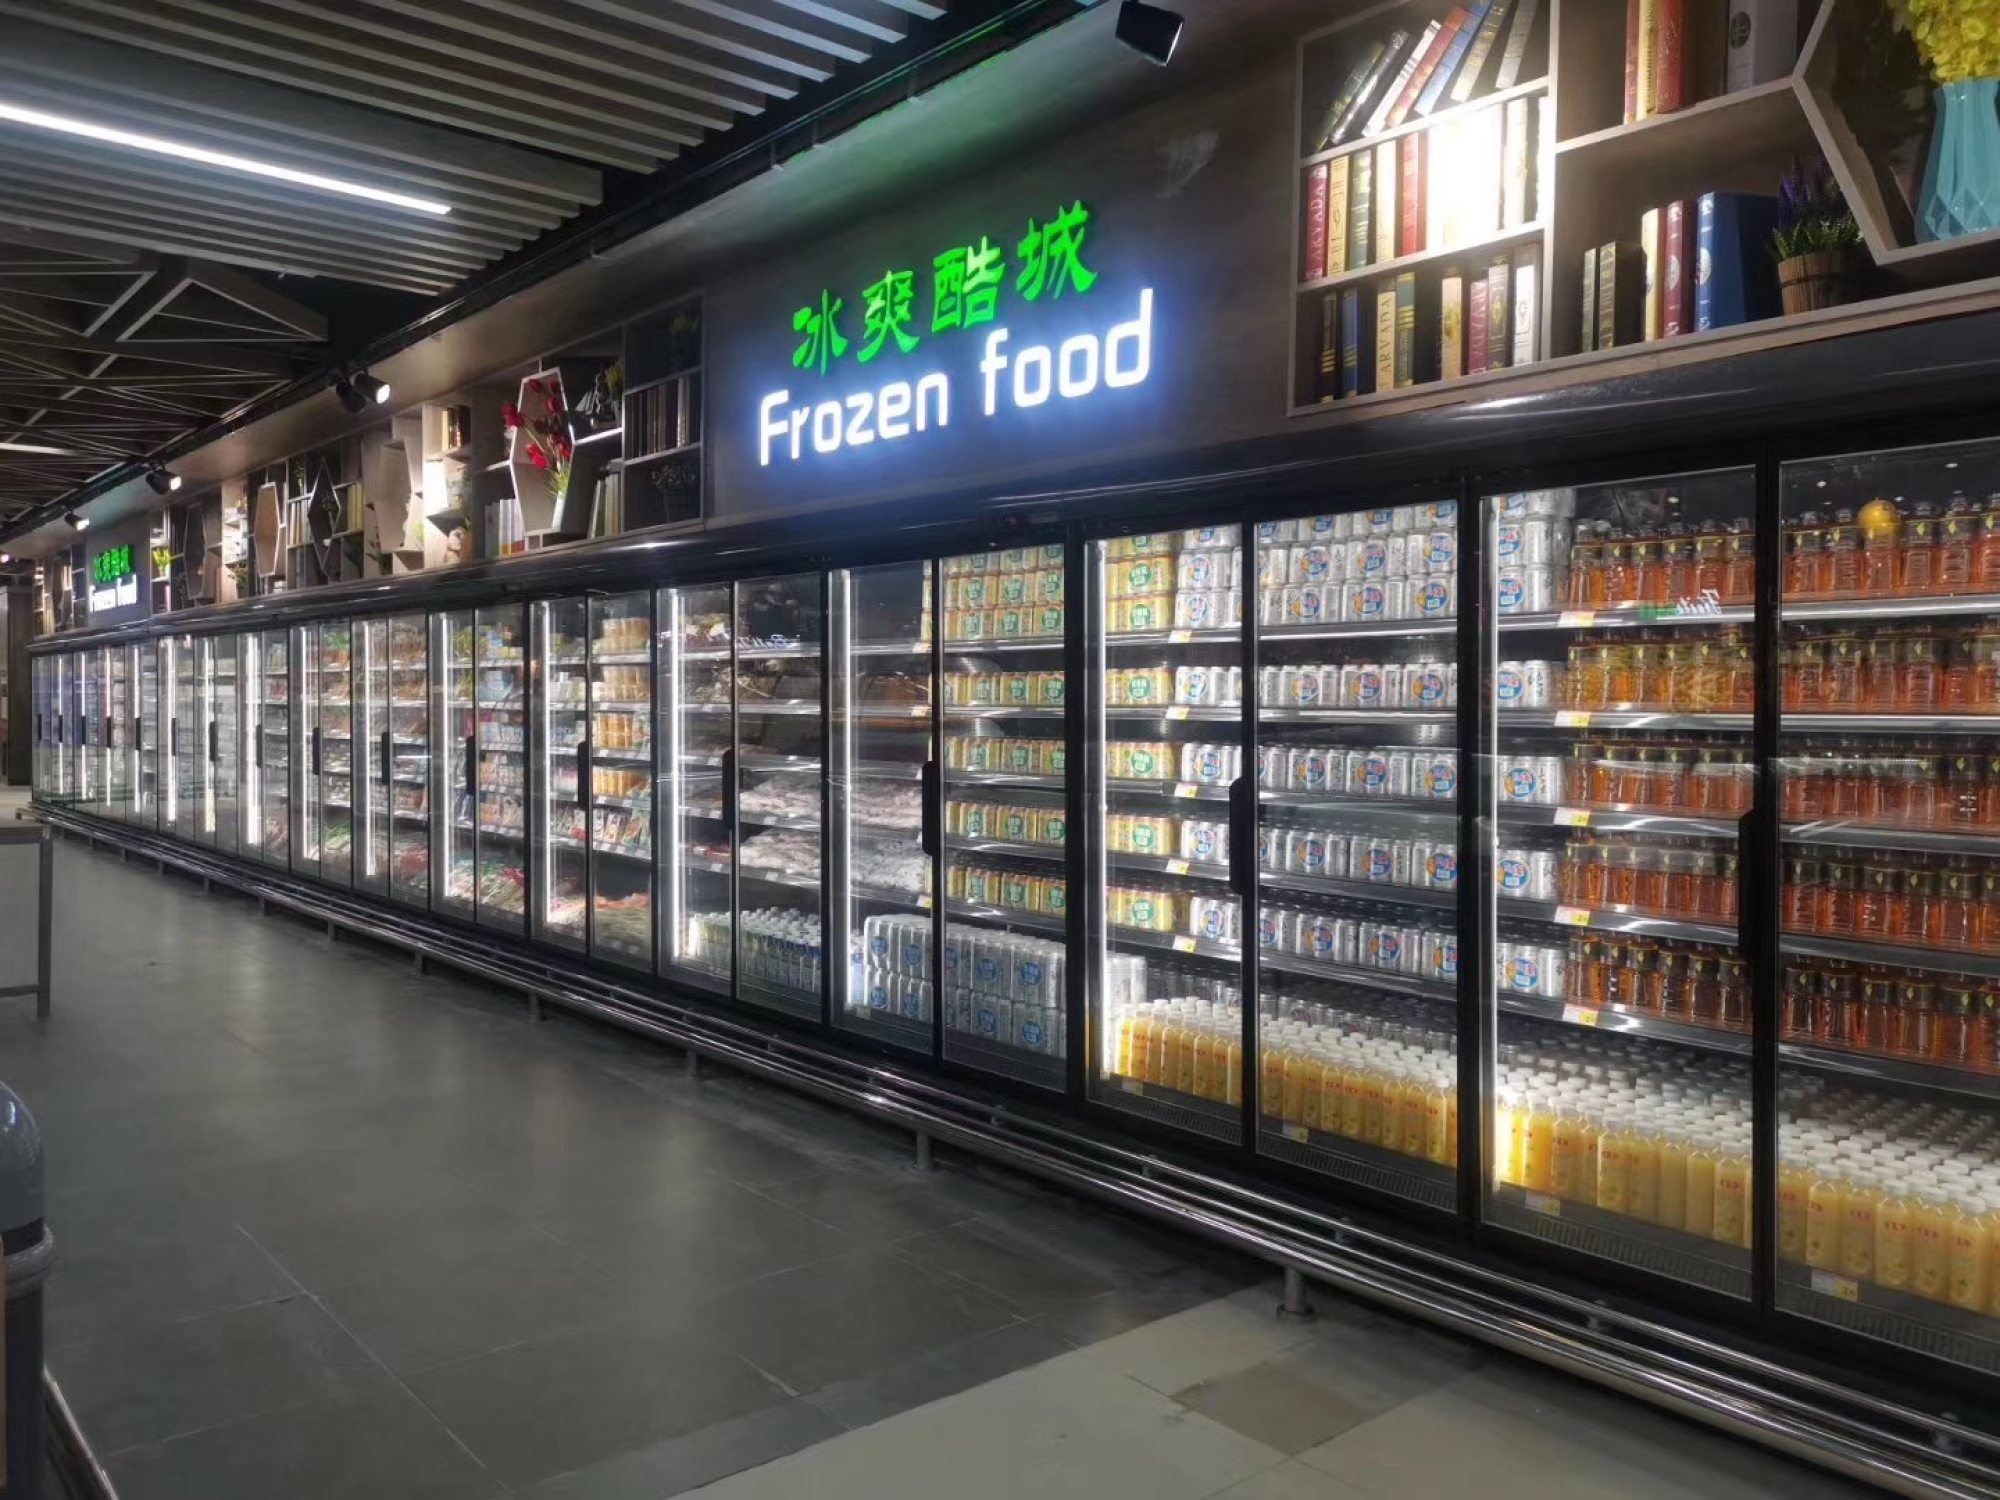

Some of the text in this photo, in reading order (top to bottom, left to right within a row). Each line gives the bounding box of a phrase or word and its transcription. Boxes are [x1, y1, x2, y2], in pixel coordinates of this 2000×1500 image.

[792, 200, 1098, 375] 冰爽酷城
[760, 288, 1154, 466] Frozen food
